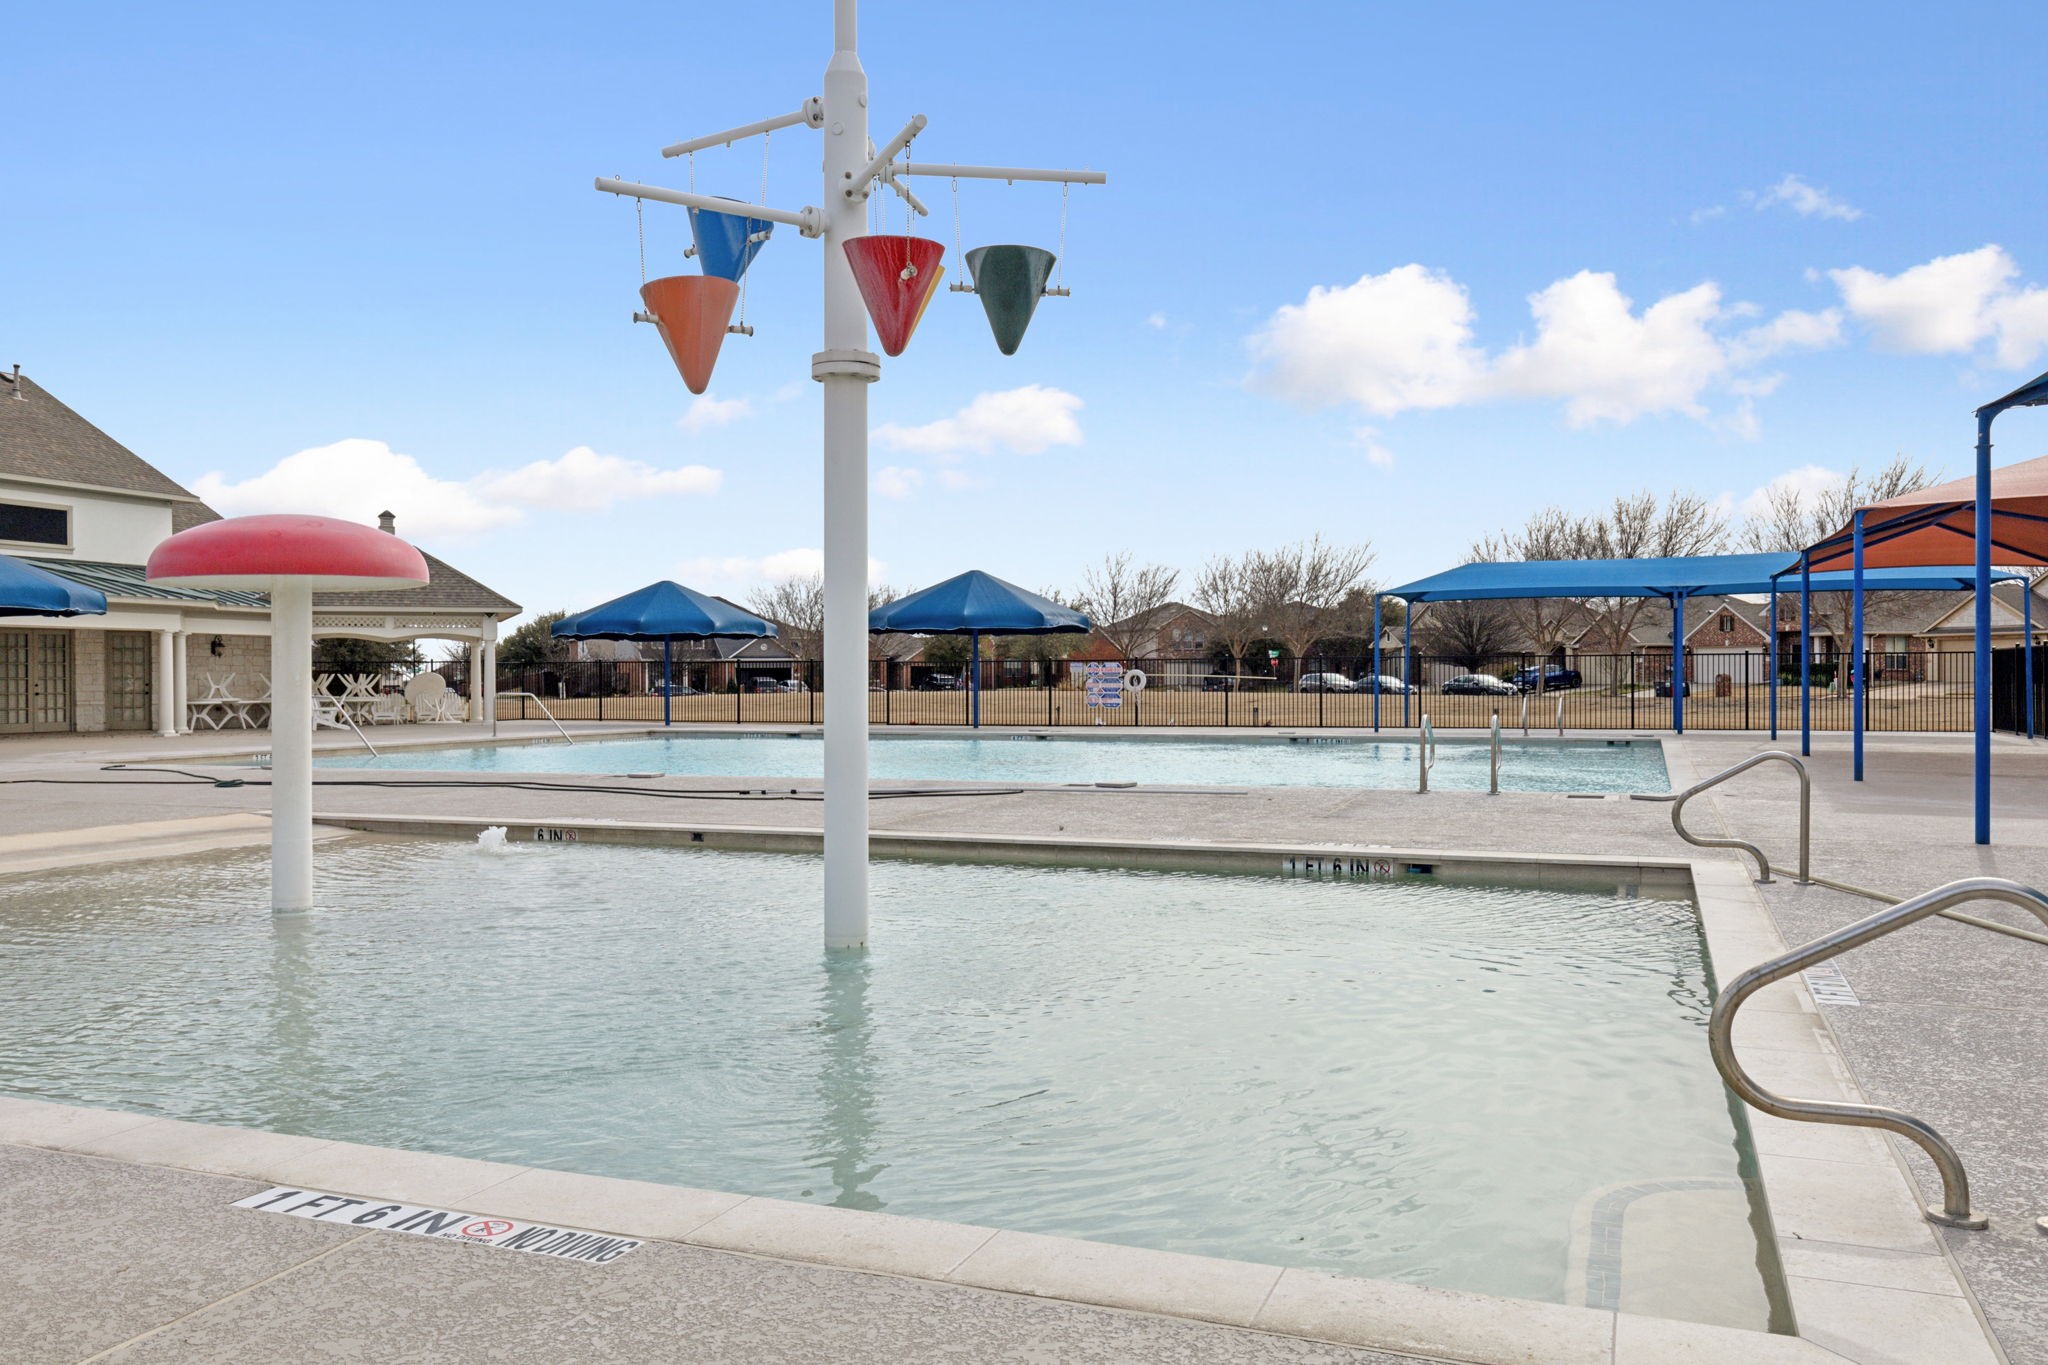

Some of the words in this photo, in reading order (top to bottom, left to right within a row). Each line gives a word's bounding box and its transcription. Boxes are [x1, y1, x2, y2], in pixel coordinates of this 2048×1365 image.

[537, 828, 544, 840] 6
[549, 829, 563, 841] IN
[1289, 857, 1296, 870] 1
[1305, 856, 1325, 870] FT
[1333, 857, 1342, 871] 6
[1350, 858, 1369, 872] IN
[252, 1191, 302, 1209] 1
[283, 1195, 367, 1218] FT
[351, 1205, 402, 1225] 6
[387, 1209, 470, 1234] IN
[496, 1226, 558, 1250] NO
[532, 1232, 640, 1263] DIVING
[456, 1235, 492, 1243] DIVING
